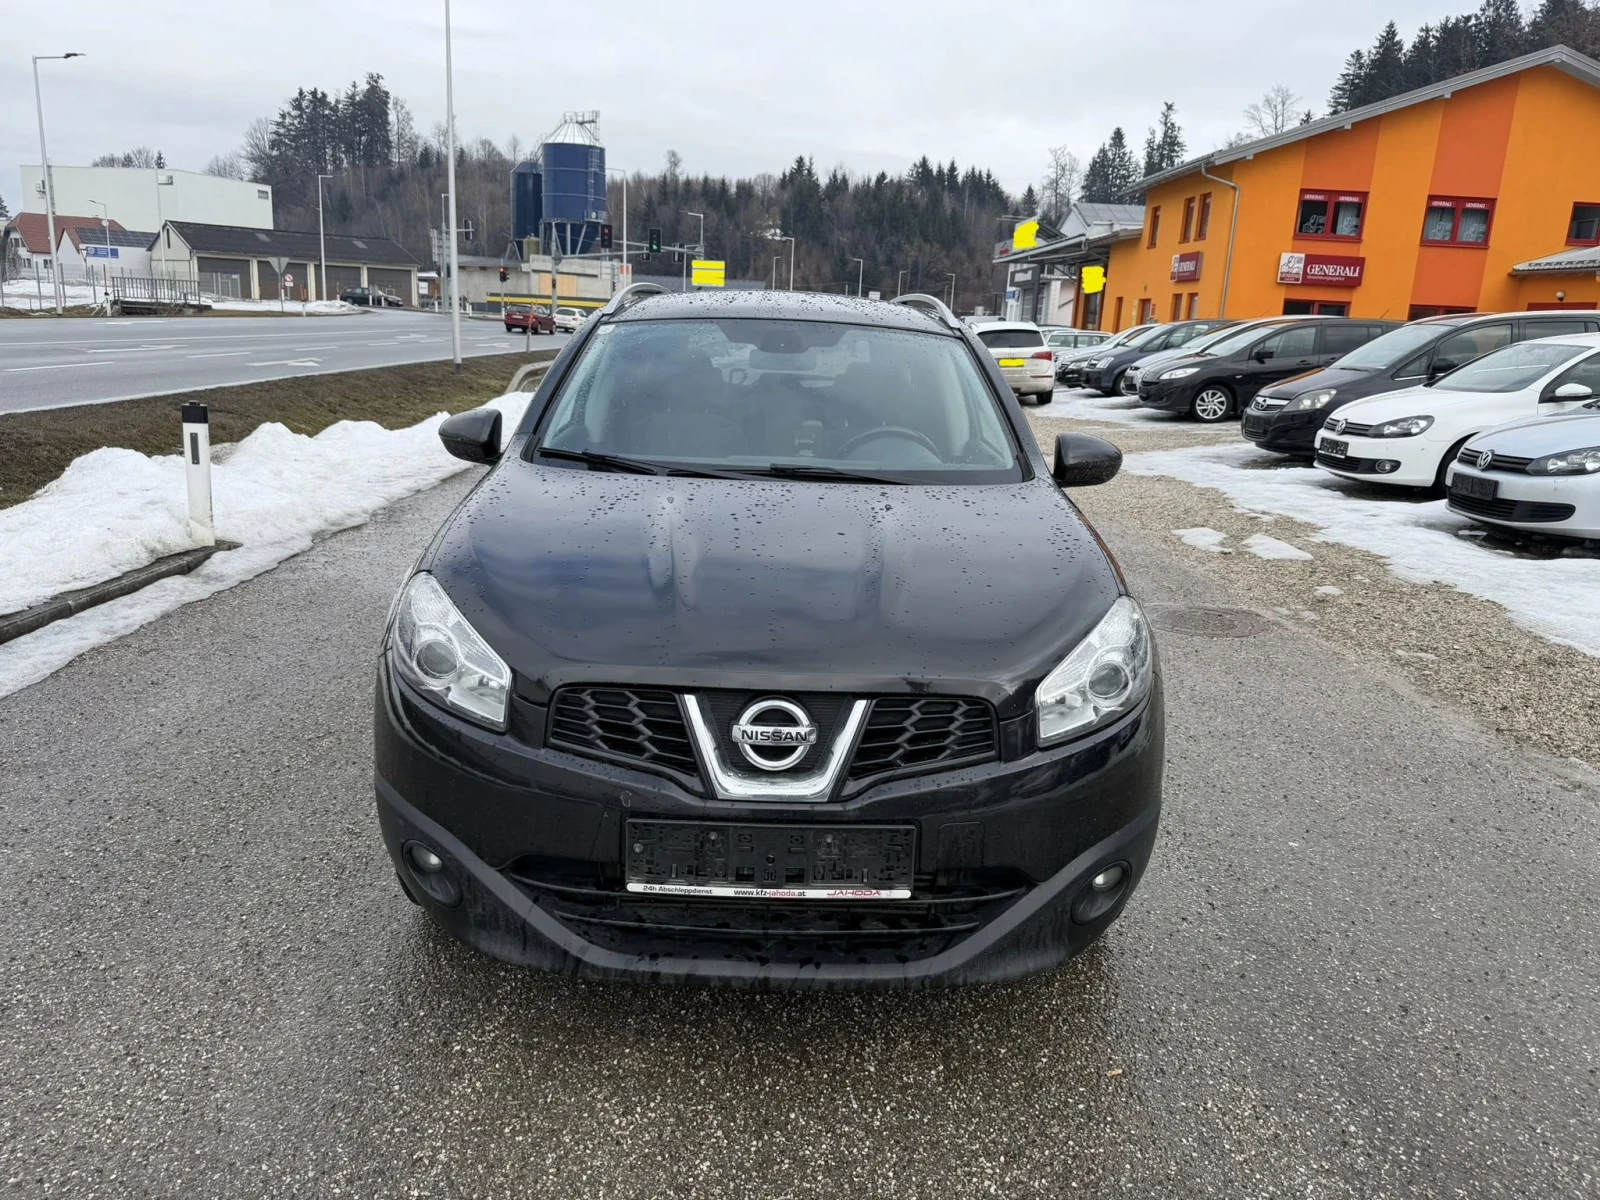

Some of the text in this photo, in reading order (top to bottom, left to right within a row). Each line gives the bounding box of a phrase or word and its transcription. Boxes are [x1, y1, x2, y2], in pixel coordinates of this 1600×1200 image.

[1306, 264, 1360, 277] GENERALI
[741, 729, 807, 742] NISSAN
[643, 884, 713, 895] 24h Abschleppdienst
[733, 889, 807, 897] www.kfz-jahoda.at
